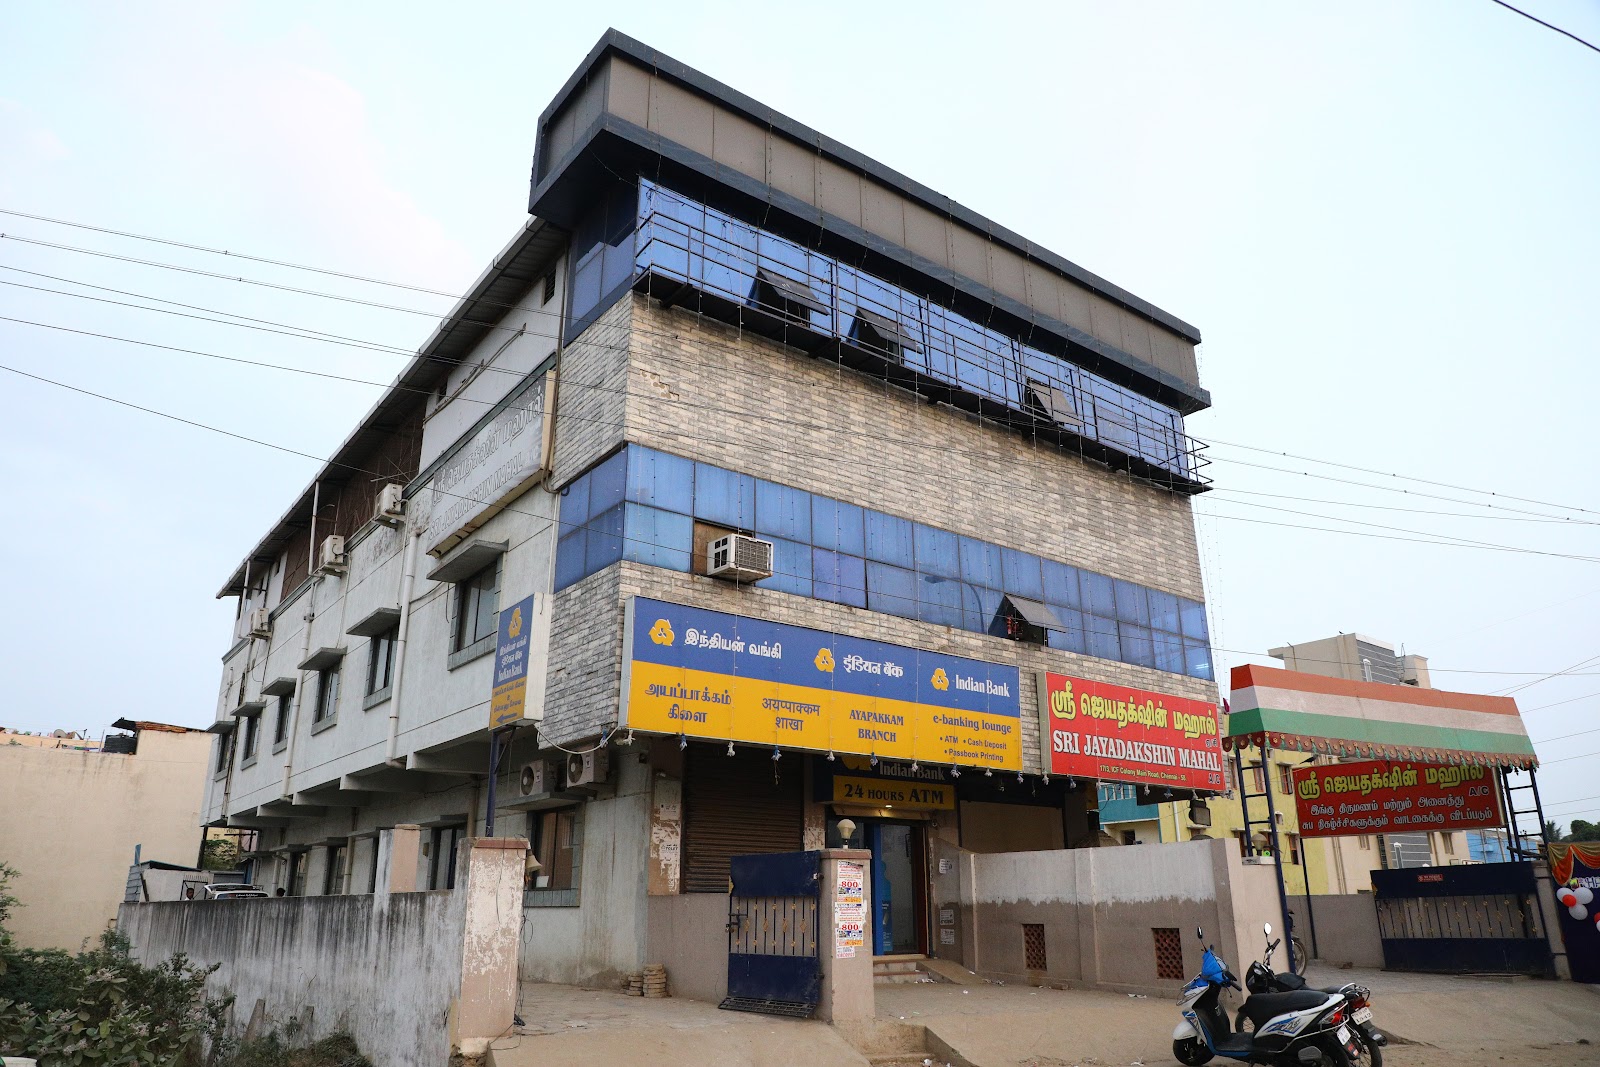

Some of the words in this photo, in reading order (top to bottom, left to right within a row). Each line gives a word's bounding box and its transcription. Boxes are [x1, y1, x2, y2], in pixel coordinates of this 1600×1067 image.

[493, 452, 522, 492] MAHAL
[684, 628, 745, 653] இந்தியன்
[749, 641, 782, 659] வங்கி
[843, 655, 881, 674] इंडियन
[884, 661, 903, 678] बैंक
[645, 683, 731, 705] அயப்பாக்கம்
[956, 674, 985, 693] Indian
[986, 680, 1010, 697] Bank
[668, 704, 707, 722] கிளை
[762, 698, 820, 716] अयप्पाक्कम
[850, 709, 904, 726] AYAPAKKAM
[1051, 680, 1076, 720] ஸ்ரீ
[1080, 693, 1168, 730] ஜெயதக்ஷின்
[1172, 709, 1217, 739] மஹால்
[775, 716, 803, 731] शाखा
[933, 714, 979, 731] e-banking
[982, 720, 1011, 735] lounge
[858, 728, 896, 742] BRANCH
[968, 738, 982, 746] Cash
[984, 740, 1007, 750] Deposit
[949, 749, 979, 758] Passbook
[981, 753, 1004, 762] Printing
[1053, 729, 1080, 754] SRI
[1084, 734, 1176, 767] JAYADAKSHIN
[1178, 747, 1221, 772] MAHAL
[880, 760, 914, 777] Indian
[916, 764, 945, 781] Bank
[1160, 772, 1178, 780] Chennai
[1208, 773, 1220, 784] A/C
[1298, 771, 1320, 799] ஸ்ரீ
[1324, 764, 1418, 796] ஜெயதக்ஷின்
[1468, 786, 1489, 797] A/C
[844, 783, 863, 798] 24
[868, 789, 904, 802] HOURS
[909, 788, 944, 804] ATM
[1310, 803, 1334, 816] இங்கு
[1339, 799, 1378, 814] திருமணம்
[1383, 798, 1412, 812] மற்றும்
[1417, 793, 1465, 808] அனைத்து
[1317, 814, 1388, 830] நிகழ்ச்சிகளுக்கும்
[1393, 810, 1445, 824] வாடகைக்கு
[1450, 806, 1493, 821] விடப்படும்
